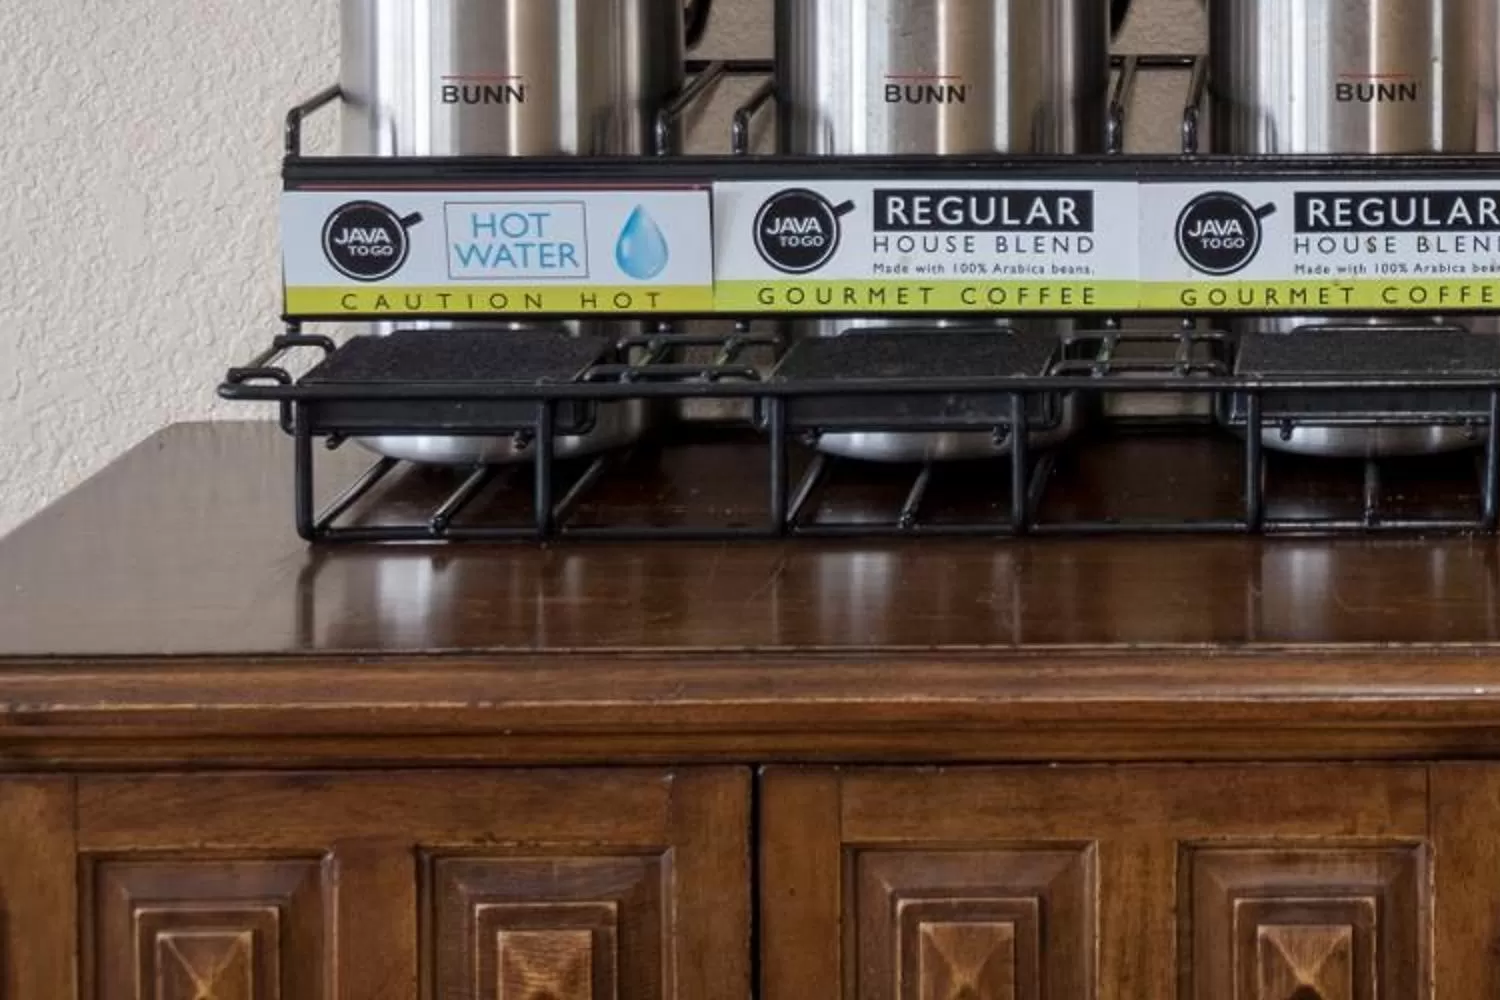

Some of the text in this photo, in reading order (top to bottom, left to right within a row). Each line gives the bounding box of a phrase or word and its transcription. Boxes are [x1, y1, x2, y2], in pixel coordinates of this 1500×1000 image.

[441, 84, 525, 104] BUNN
[885, 84, 966, 104] BUNN
[1335, 82, 1417, 103] BUNN
[886, 196, 1080, 226] REGULAR
[1307, 197, 1500, 227] REGULAR
[471, 212, 551, 239] HOT
[766, 216, 823, 236] JAVA
[1187, 219, 1244, 237] JAVA
[333, 227, 393, 245] JAVA
[778, 235, 825, 248] TO GO
[872, 235, 1095, 254] HOUSE BLEND
[1201, 237, 1246, 249] TO GO
[1294, 235, 1398, 254] HOUSE
[347, 245, 394, 257] TO GO
[454, 242, 580, 269] WATER
[872, 262, 909, 275] Made
[915, 262, 945, 275] with
[952, 262, 988, 275] 100%
[992, 262, 1045, 275] Arabica
[1294, 262, 1331, 275] Made
[1336, 262, 1368, 275] with
[1374, 262, 1408, 275] 100%
[1413, 262, 1466, 275] Arabica
[340, 291, 661, 311] CAUTION HOT
[757, 286, 1096, 306] GOURMET COFFEE
[1180, 286, 1355, 307] GOURMET
